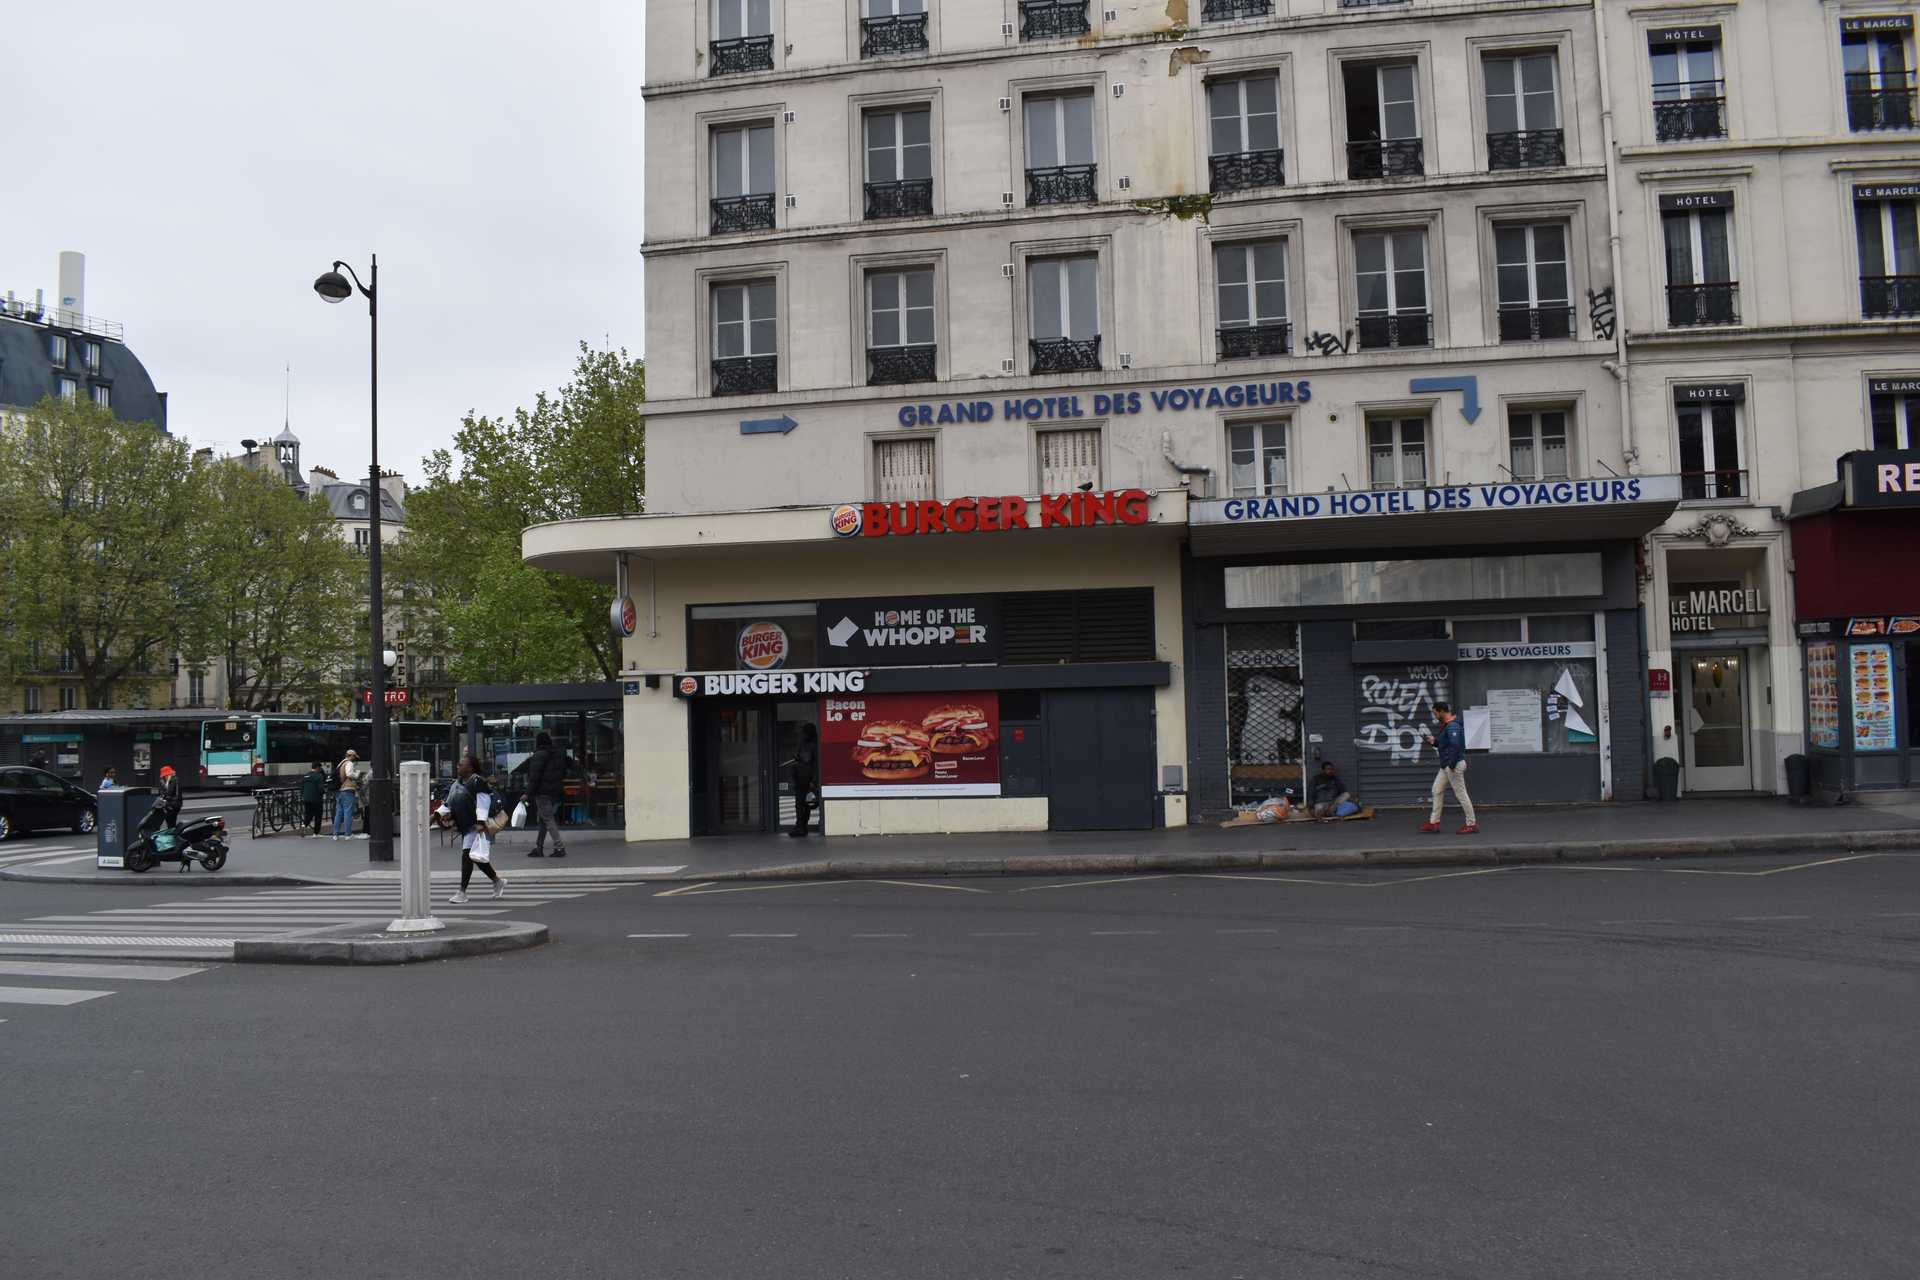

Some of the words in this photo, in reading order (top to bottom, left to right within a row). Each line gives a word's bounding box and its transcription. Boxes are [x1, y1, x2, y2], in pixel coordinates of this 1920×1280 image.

[1863, 18, 1908, 28] MARCEL
[1858, 188, 1872, 197] LE
[898, 401, 994, 427] GRAND
[1004, 395, 1084, 420] HOTEL
[1094, 391, 1141, 415] DES
[1151, 381, 1312, 411] VOYAGEURS
[1878, 463, 1920, 492] RE
[1224, 496, 1320, 520] GRAND
[1331, 491, 1414, 515] HOTEL
[1424, 487, 1471, 510] DES
[1481, 479, 1641, 506] VOYAGEURS
[863, 495, 1029, 537] BURGER
[1040, 489, 1149, 528] KING
[835, 516, 857, 529] KING
[1671, 600, 1688, 615] LE
[1689, 589, 1767, 614] MARCEL
[874, 610, 922, 626] HOME
[926, 609, 944, 625] OF
[948, 608, 976, 623] THE
[1671, 616, 1715, 632] HOTEL
[741, 631, 783, 647] BURGER
[863, 625, 987, 647] WHOPPER
[742, 641, 784, 659] KING
[1476, 648, 1498, 658] DES
[1501, 645, 1572, 657] VOYAGEURS
[704, 673, 798, 695] BURGER
[803, 671, 865, 693] KING
[826, 699, 865, 710] Bacon
[826, 710, 866, 721] Loer
